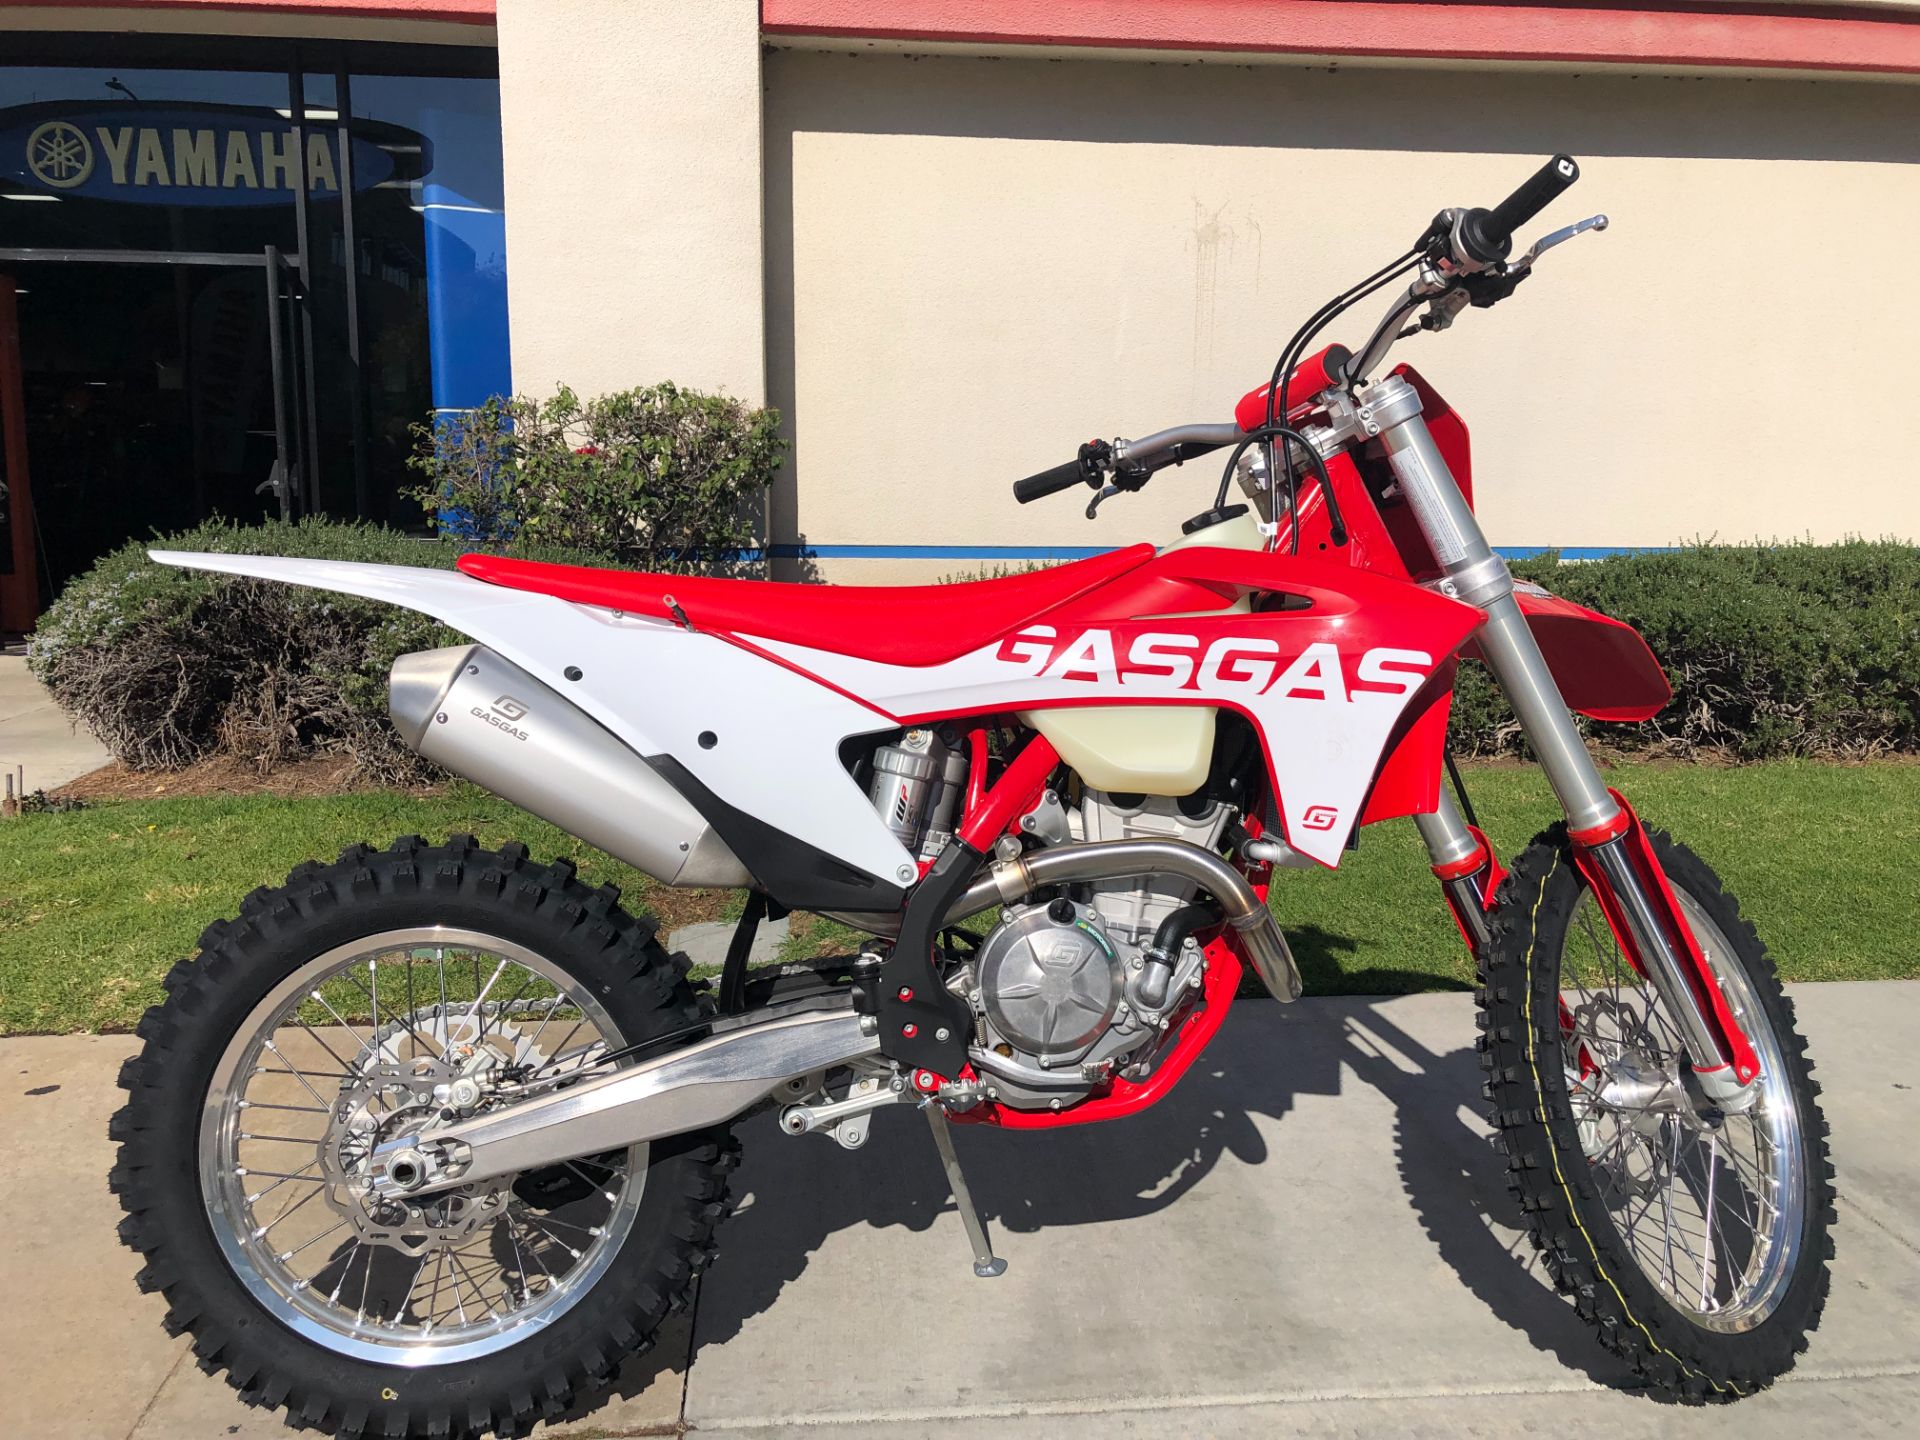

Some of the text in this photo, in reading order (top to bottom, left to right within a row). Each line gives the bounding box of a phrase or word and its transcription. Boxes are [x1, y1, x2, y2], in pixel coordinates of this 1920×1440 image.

[96, 127, 338, 191] YAMAHA
[995, 624, 1432, 702] GASGAS
[470, 706, 529, 741] GASGAS
